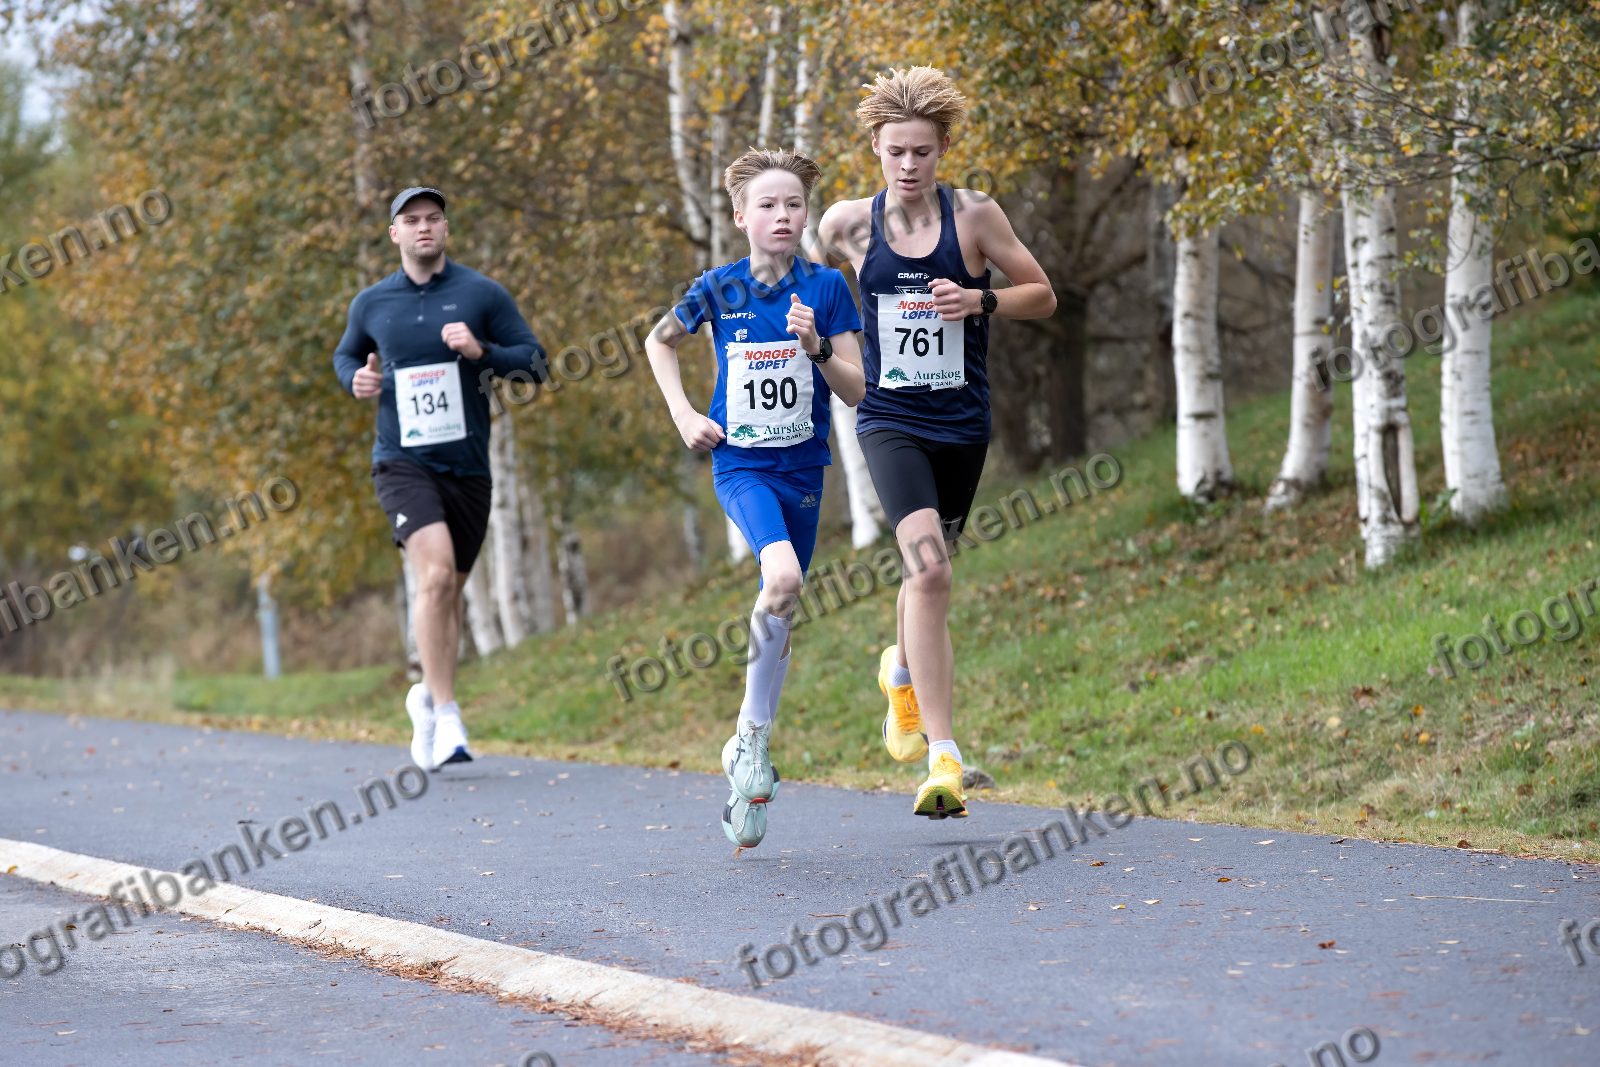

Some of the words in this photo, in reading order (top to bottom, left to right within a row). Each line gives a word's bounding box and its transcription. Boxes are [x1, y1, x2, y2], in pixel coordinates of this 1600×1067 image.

[897, 300, 935, 311] NORG
[720, 312, 748, 320] CRAFT
[894, 327, 944, 357] 761
[744, 348, 797, 360] NORGES
[748, 359, 789, 371] LØPET
[913, 368, 962, 382] Aurskog
[743, 376, 798, 411] 190
[410, 390, 449, 416] 134
[763, 421, 811, 436] Aurskog
